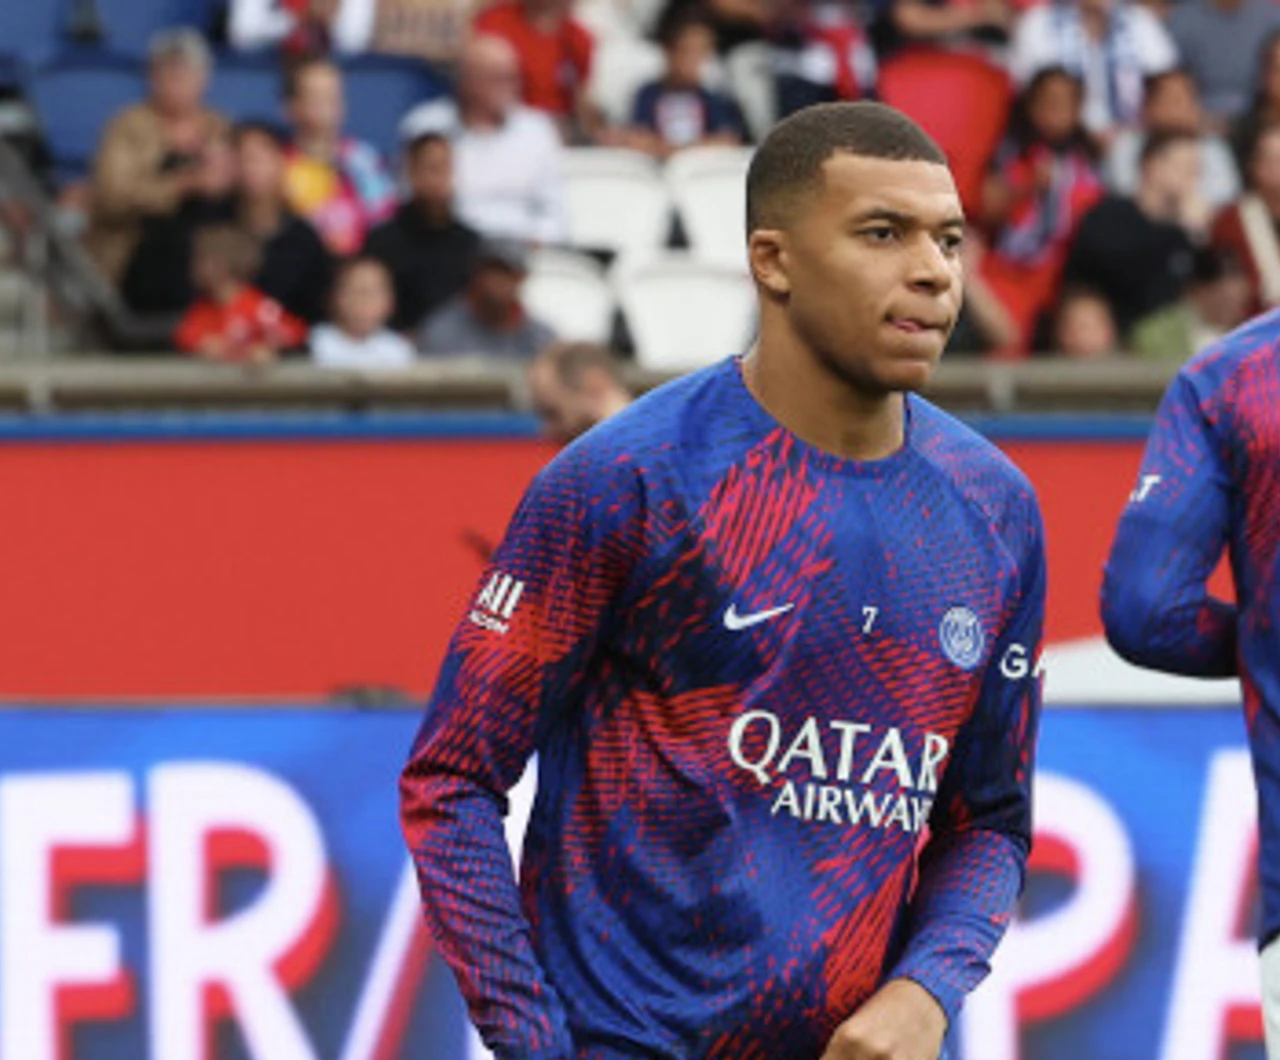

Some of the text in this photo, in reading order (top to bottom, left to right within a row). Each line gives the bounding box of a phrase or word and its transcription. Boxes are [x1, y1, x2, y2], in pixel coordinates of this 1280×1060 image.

[862, 605, 879, 634] 7
[728, 709, 949, 794] QATAR
[770, 780, 933, 834] AIRWAY
